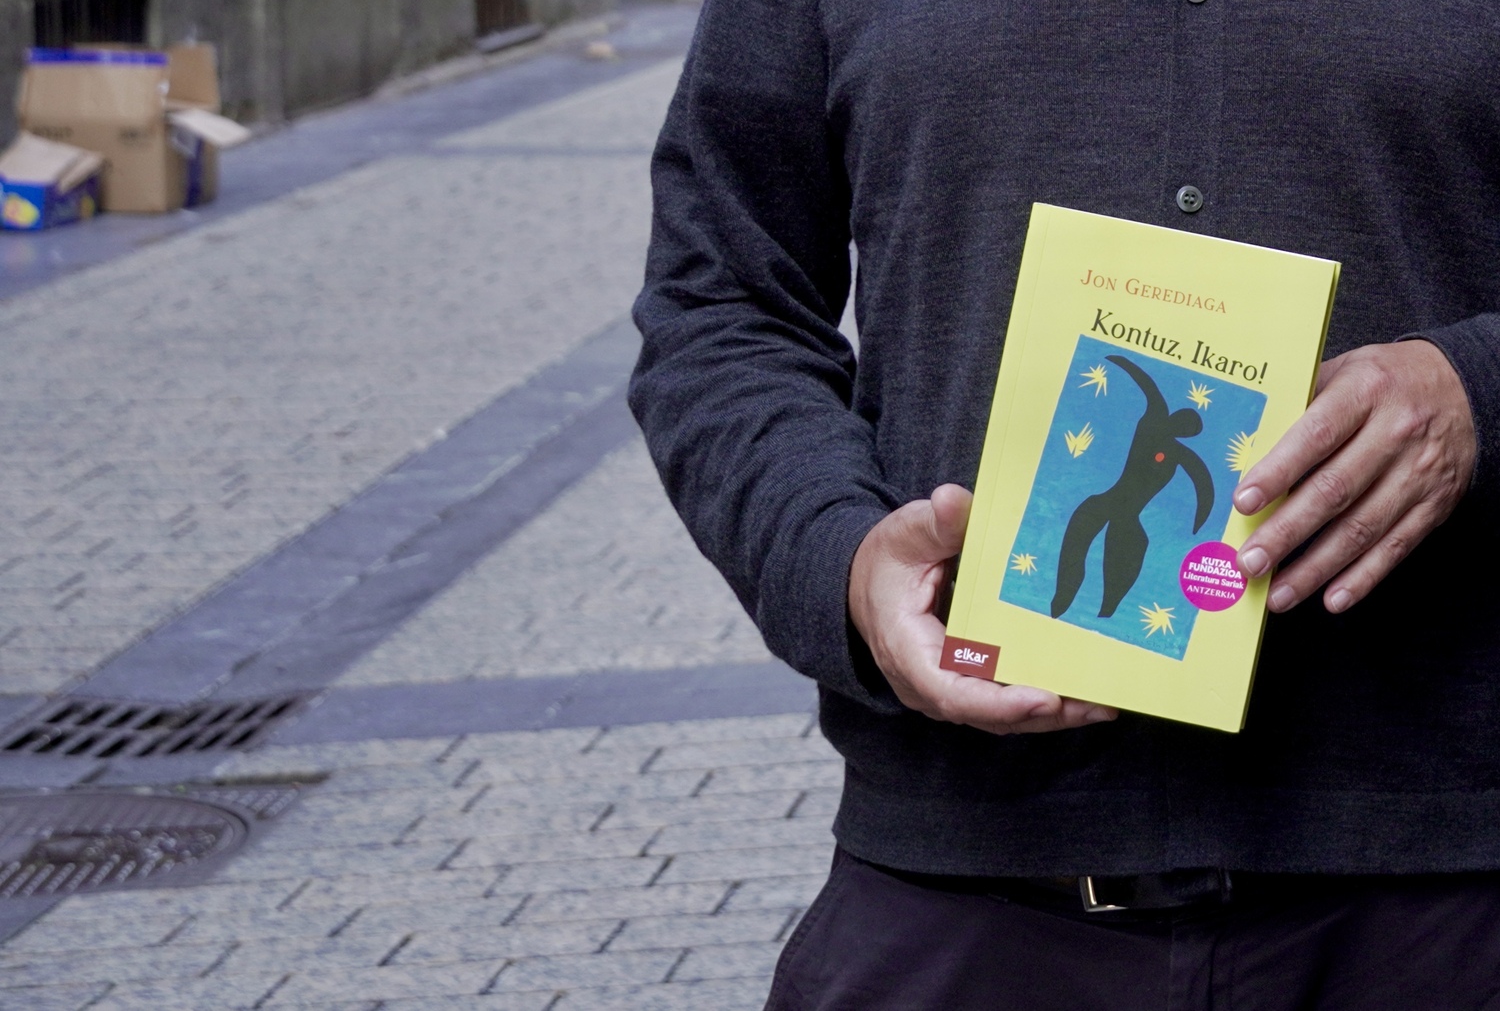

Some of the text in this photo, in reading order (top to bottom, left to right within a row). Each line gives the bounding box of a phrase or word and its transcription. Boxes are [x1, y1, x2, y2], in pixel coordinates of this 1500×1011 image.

[1080, 269, 1227, 314] JON GEREDIAGA
[1090, 308, 1269, 385] Kontuz, Ikaro!
[1188, 562, 1242, 579] FUNDAZIOA
[1201, 556, 1232, 569] KUTXA
[1183, 571, 1244, 589] Literatura Sariak
[1186, 584, 1236, 600] ANTZERKIA
[954, 647, 989, 664] elkar
